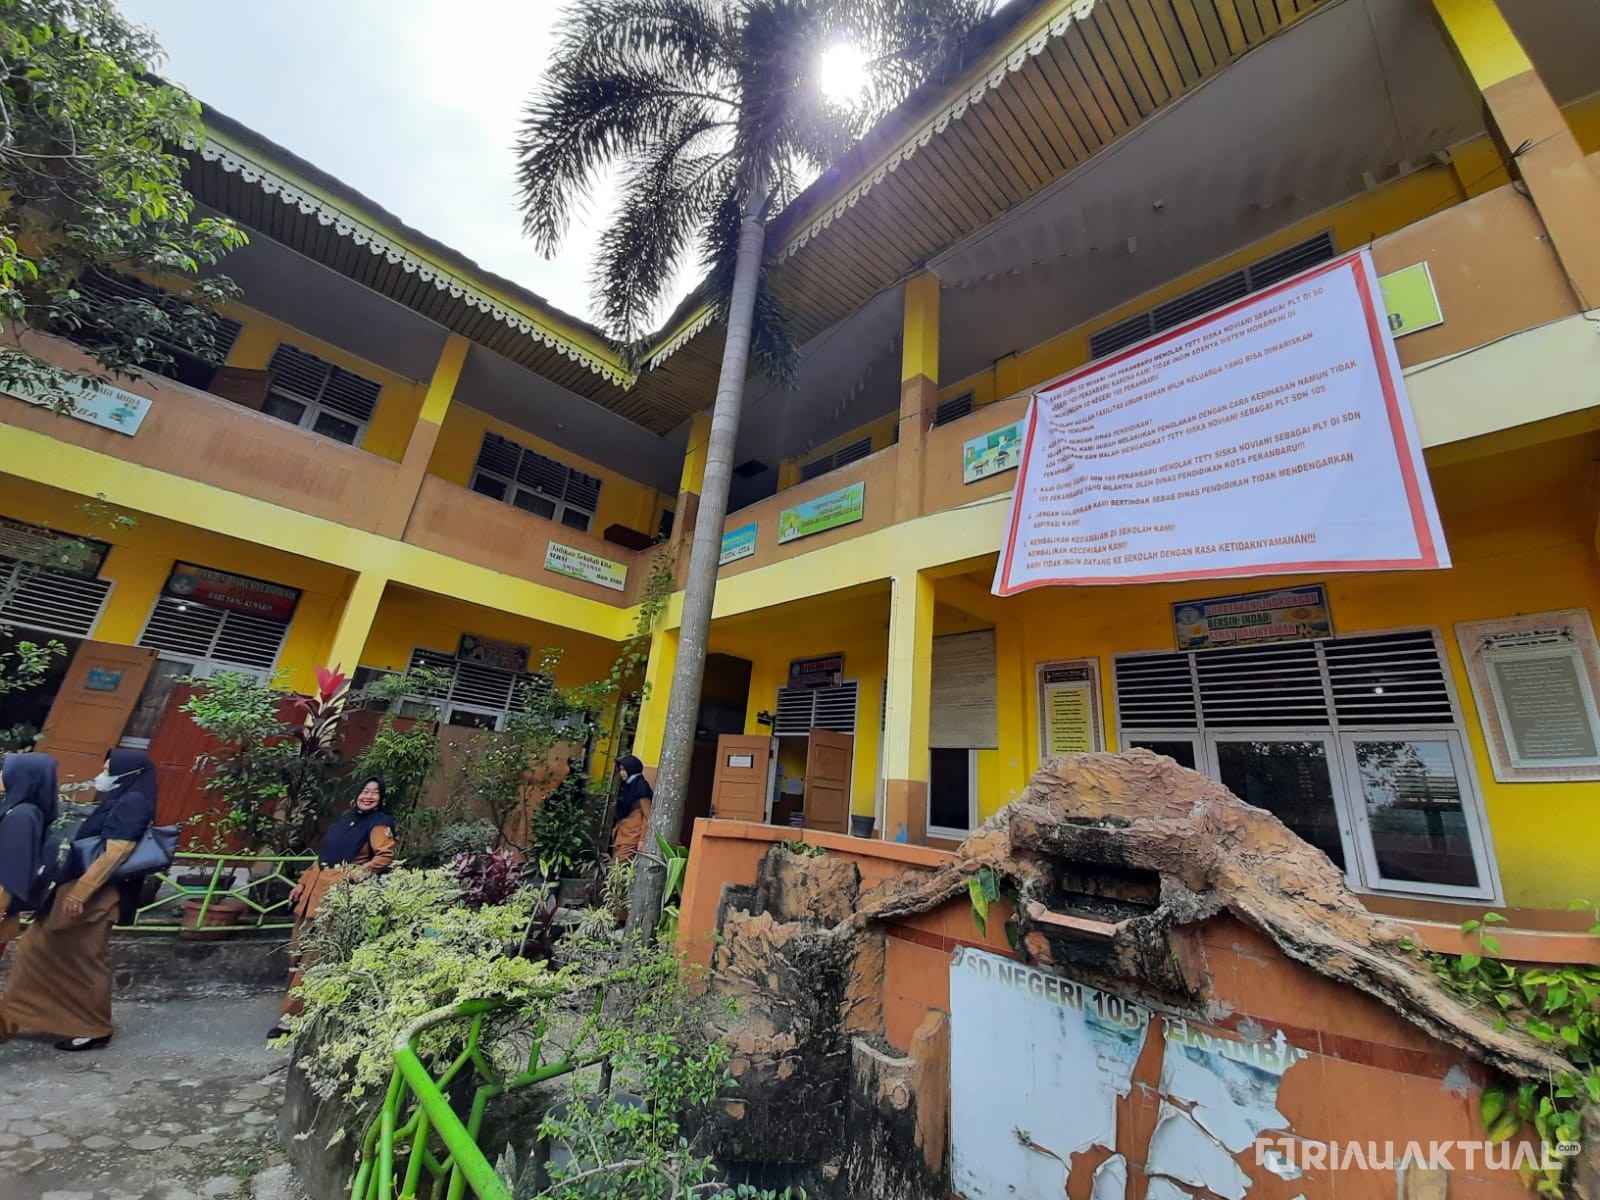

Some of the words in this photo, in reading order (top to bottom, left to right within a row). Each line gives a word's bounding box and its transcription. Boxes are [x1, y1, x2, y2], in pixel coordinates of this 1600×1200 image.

[1079, 383, 1111, 401] PEKANBARU
[1111, 374, 1135, 387] KARENA
[1135, 367, 1152, 377] KAMI
[1153, 359, 1171, 371] TIDAK
[1172, 351, 1190, 365] INGIN
[1191, 341, 1219, 356] ADANYA
[1220, 331, 1246, 345] SISTEM
[1287, 310, 1296, 319] DI
[1118, 358, 1153, 374] PEKANBARU
[1154, 346, 1183, 361] MENOLAK
[1184, 339, 1201, 350] TETY
[1202, 330, 1223, 342] SISKA
[1223, 318, 1253, 334] NOVIANI
[1254, 304, 1286, 321] SEBAGAI
[1287, 296, 1301, 307] PLT
[1303, 292, 1311, 300] DI
[1313, 286, 1325, 297] SD
[1091, 392, 1112, 405] NEGERI
[1123, 374, 1160, 393] PEKANBARU
[1095, 402, 1124, 417] FASILITAS
[1144, 386, 1166, 400] BUKAN
[1167, 379, 1185, 391] MILIK
[1186, 365, 1223, 384] KELUARGA
[1224, 356, 1244, 371] YANG
[1245, 350, 1263, 363] BISA
[1264, 331, 1314, 355] DIWARISKAN
[1095, 440, 1117, 450] SUDAH
[1117, 428, 1156, 446] MELAKUKAN
[1157, 415, 1197, 433] PENOLAKAN
[1198, 403, 1228, 419] DENGAN
[1229, 396, 1249, 410] CARA
[1250, 382, 1296, 403] KEDINASAN
[1297, 370, 1329, 388] NAMUN
[1330, 359, 1357, 375] TIDAK
[1121, 436, 1166, 454] MENGANGKAT
[1167, 430, 1185, 441] TETY
[1186, 422, 1206, 435] SISKA
[1207, 412, 1238, 428] NOVIANI
[1239, 402, 1273, 418] SEBAGAI
[1275, 396, 1289, 407] PLT
[1291, 389, 1309, 402] SDN
[1311, 384, 1326, 396] 105
[1094, 432, 1112, 442] DINAS
[1117, 466, 1158, 481] PEKANBARU
[1159, 459, 1192, 474] MENOLAK
[1194, 452, 1213, 464] TETY
[1215, 446, 1238, 459] SISKA
[1239, 436, 1273, 451] NOVIANI
[1274, 426, 1311, 443] SEBAGAI
[1313, 420, 1329, 432] PLT
[1331, 416, 1340, 426] DI
[1342, 410, 1361, 424] SDN
[1102, 481, 1134, 492] DILANTIK
[1135, 479, 1154, 489] OLEH
[1155, 474, 1177, 486] DINAS
[1178, 463, 1223, 481] PENDIDIKAN
[1224, 456, 1247, 469] KOTA
[1247, 441, 1306, 463] PEKANBARU!!!
[1110, 498, 1150, 507] BERTINDAK
[1152, 493, 1176, 504] SEBAB
[1177, 488, 1200, 501] DINAS
[1201, 477, 1250, 495] PENDIDIKAN
[1251, 472, 1277, 484] TIDAK
[1278, 452, 1354, 478] MENDENGARKAN
[1028, 547, 1069, 558] KEMBALIKAN
[1069, 545, 1107, 555] KECERIAAN
[1030, 536, 1070, 547] KEMBALIKAN
[1071, 532, 1109, 544] KEDAMAIAN
[1110, 529, 1117, 537] DI
[1118, 526, 1152, 537] SEKOLAH
[1033, 520, 1061, 529] ASPIRASI
[1042, 559, 1061, 568] TIDAK
[1062, 558, 1081, 566] INGIN
[1082, 557, 1111, 566] DATANG
[1112, 556, 1122, 565] KE
[1124, 551, 1158, 564] SEKOLAH
[1160, 545, 1193, 559] DENGAN
[1194, 544, 1217, 555] RASA
[1218, 533, 1316, 552] KETIDAKNYAMANAN!!!
[999, 964, 1084, 1012] NEGERI
[1093, 991, 1139, 1028] 105
